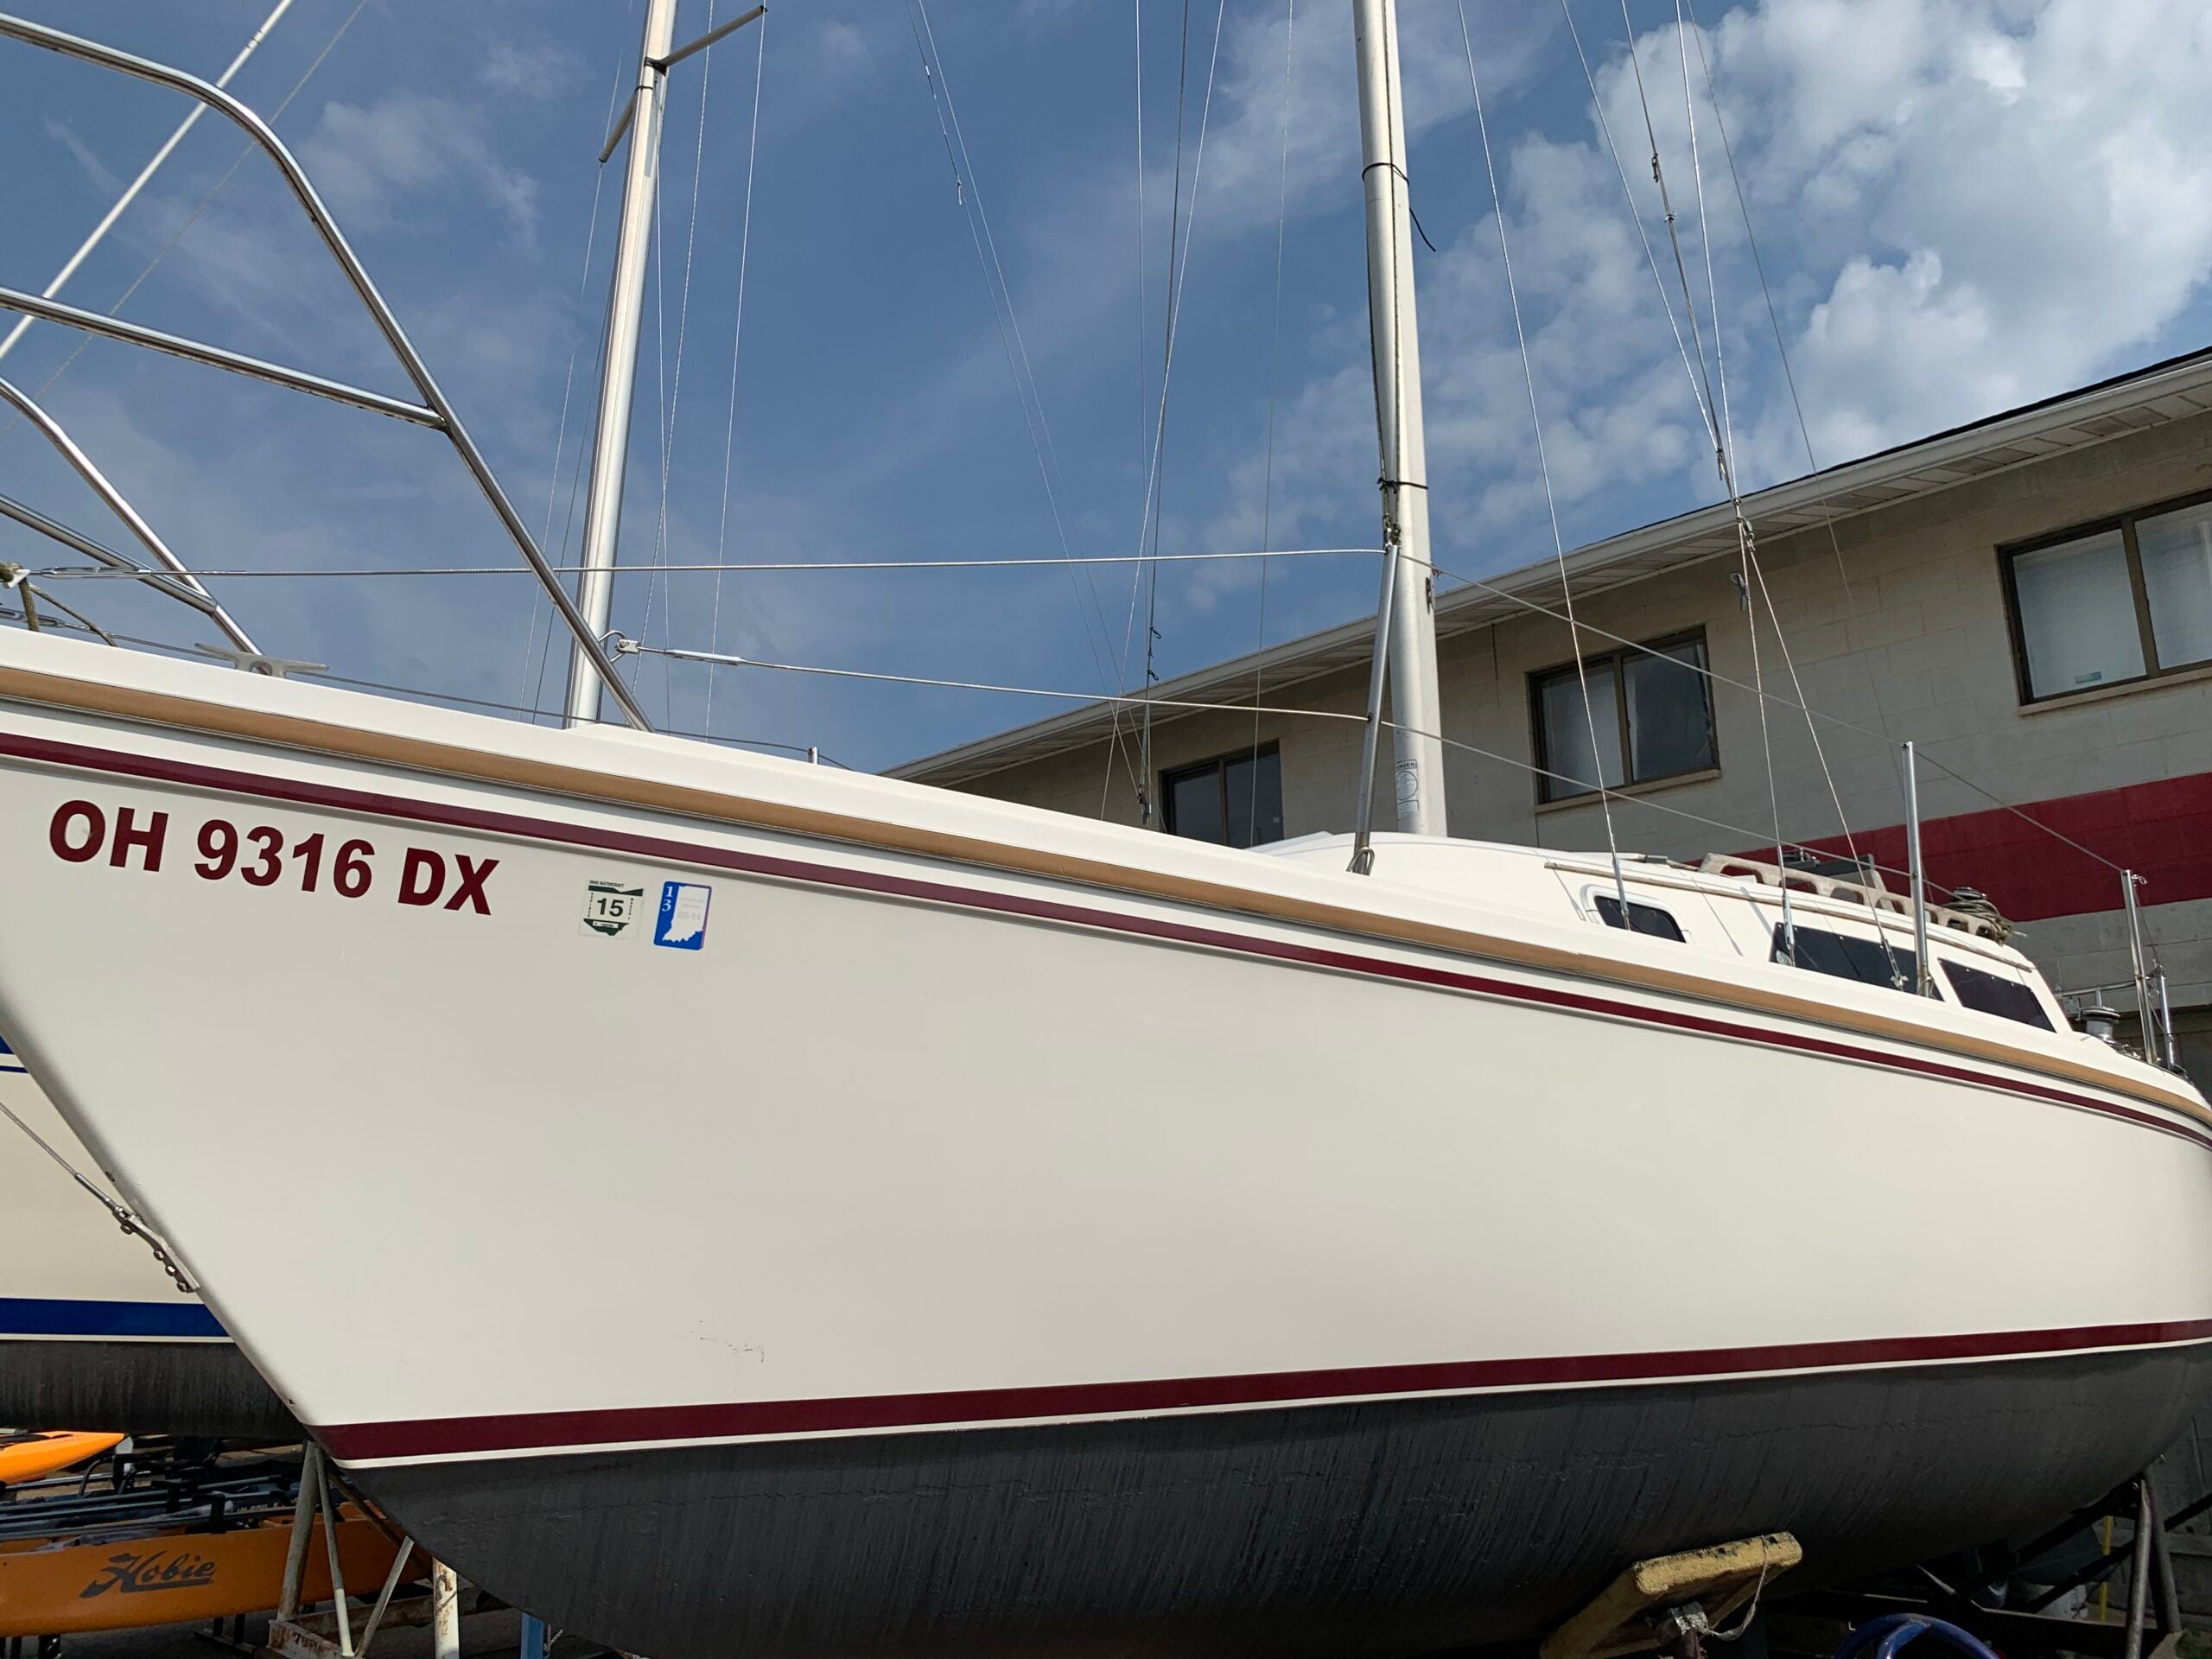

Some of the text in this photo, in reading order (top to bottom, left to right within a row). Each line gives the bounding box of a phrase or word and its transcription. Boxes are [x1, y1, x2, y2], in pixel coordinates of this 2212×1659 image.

[49, 799, 500, 916] OH 9316 DX
[597, 898, 624, 917] 15
[79, 1550, 215, 1598] Hobie
